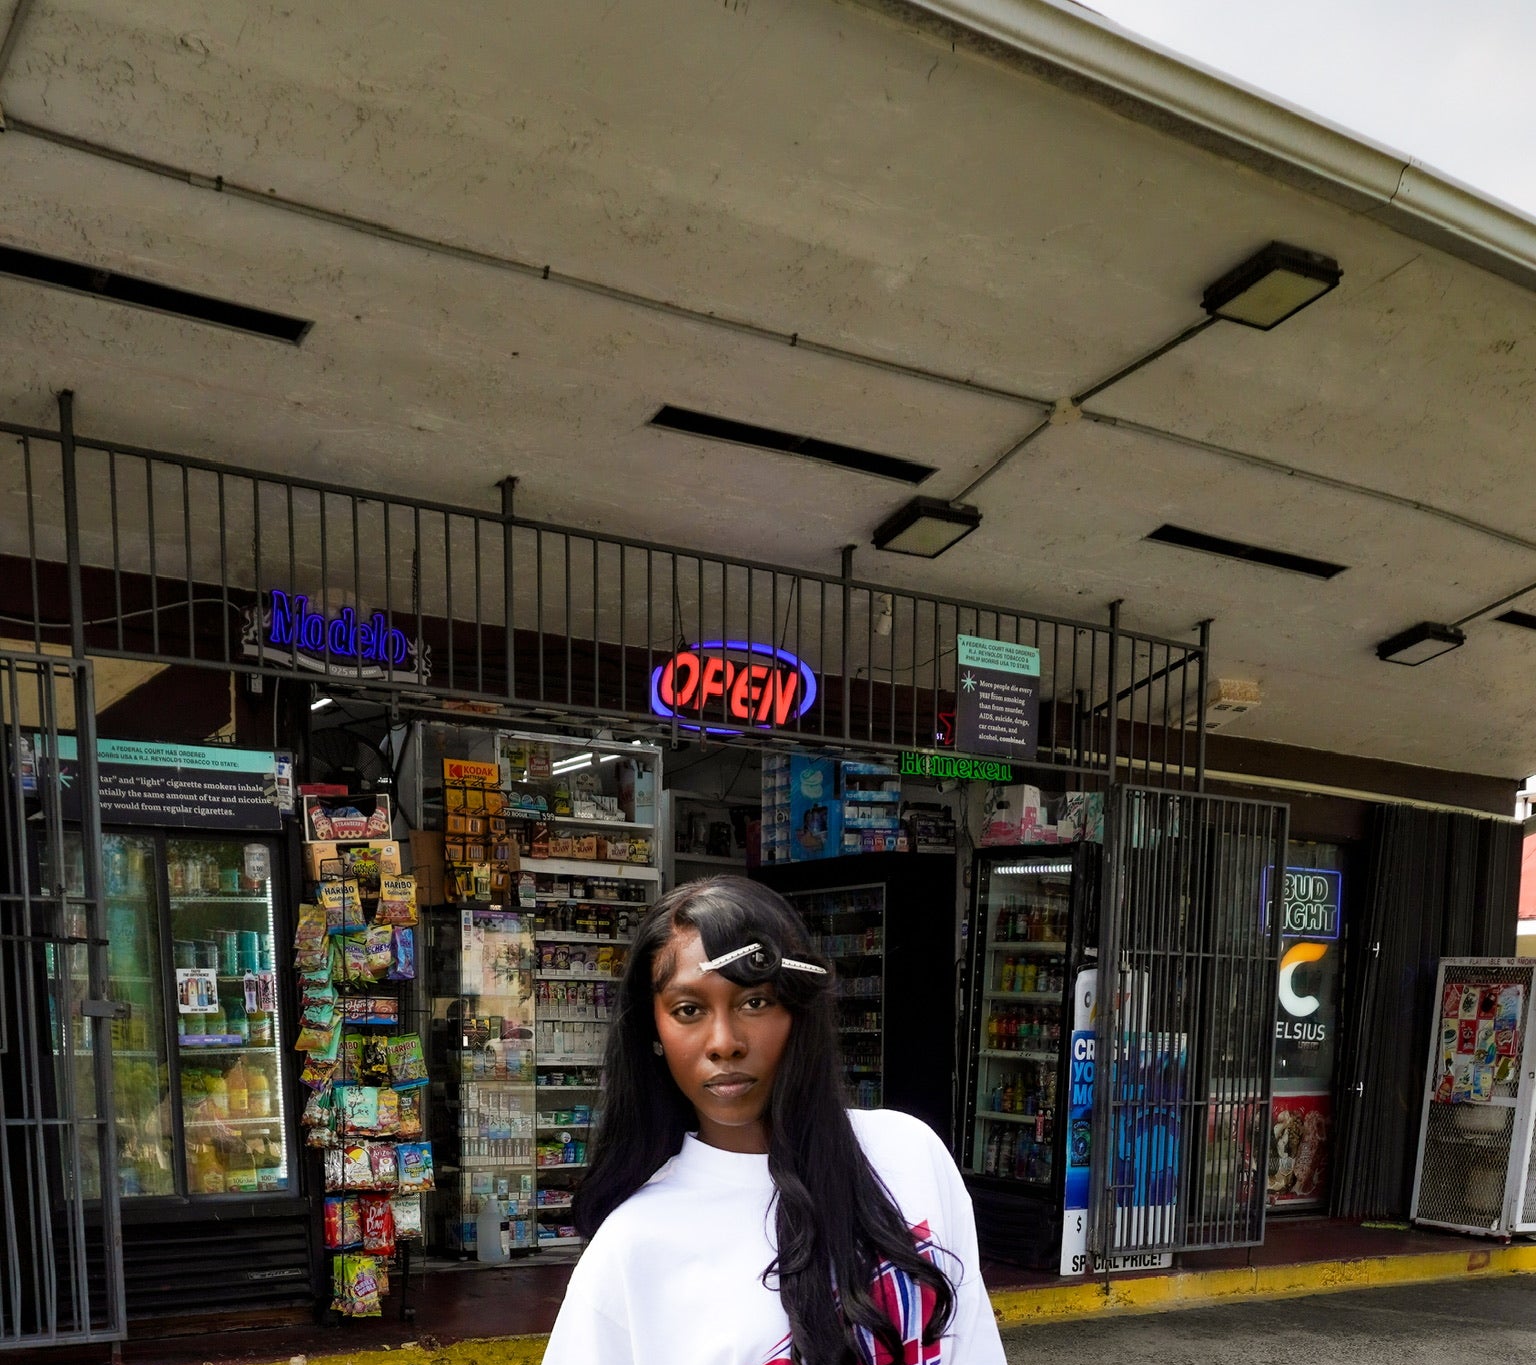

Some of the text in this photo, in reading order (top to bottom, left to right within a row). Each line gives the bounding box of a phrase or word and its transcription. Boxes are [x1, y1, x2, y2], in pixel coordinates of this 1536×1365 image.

[271, 590, 407, 663] Modelo
[966, 641, 988, 650] FEDERAL
[988, 644, 1005, 653] COURT
[1015, 648, 1036, 658] ORDERED
[978, 649, 1003, 659] REYNOLDS
[1003, 653, 1026, 663] TOBACCO
[965, 655, 981, 663] PHILIP
[981, 657, 999, 665] MORRIS
[1000, 659, 1009, 667] USA
[661, 652, 798, 725] OPEN
[979, 679, 993, 689] More
[993, 682, 1010, 693] people
[1018, 686, 1033, 696] every
[979, 691, 1026, 706] year from smoking
[979, 702, 1025, 715] than from murder,
[978, 712, 1030, 727] AIDS, suicide, drugs,
[987, 724, 1008, 733] crashes,
[1008, 726, 1018, 734] and
[978, 733, 1027, 745] alcohol, combined.
[116, 746, 143, 754] FEDERAL
[144, 747, 164, 755] COURT
[178, 750, 206, 758] ORDERED
[150, 756, 182, 764] REYNOLDS
[183, 758, 211, 766] TOBACCO
[901, 750, 1013, 782] Heineken
[463, 766, 494, 777] KODAK
[118, 776, 134, 785] and
[166, 779, 202, 791] cigarette
[203, 782, 237, 791] smokers
[238, 784, 264, 792] inhale
[99, 788, 272, 804] ntially the same amount of tar and nicotine
[100, 801, 236, 817] hey would from regular cigarettes.
[324, 883, 355, 896] HARIBO
[384, 879, 412, 890] HARIBO
[1283, 873, 1329, 904] BUD
[1276, 1021, 1327, 1041] ELSIUS
[388, 1040, 417, 1054] HARIBO
[1076, 1216, 1083, 1234] $
[1072, 1253, 1120, 1272] SPCIAL
